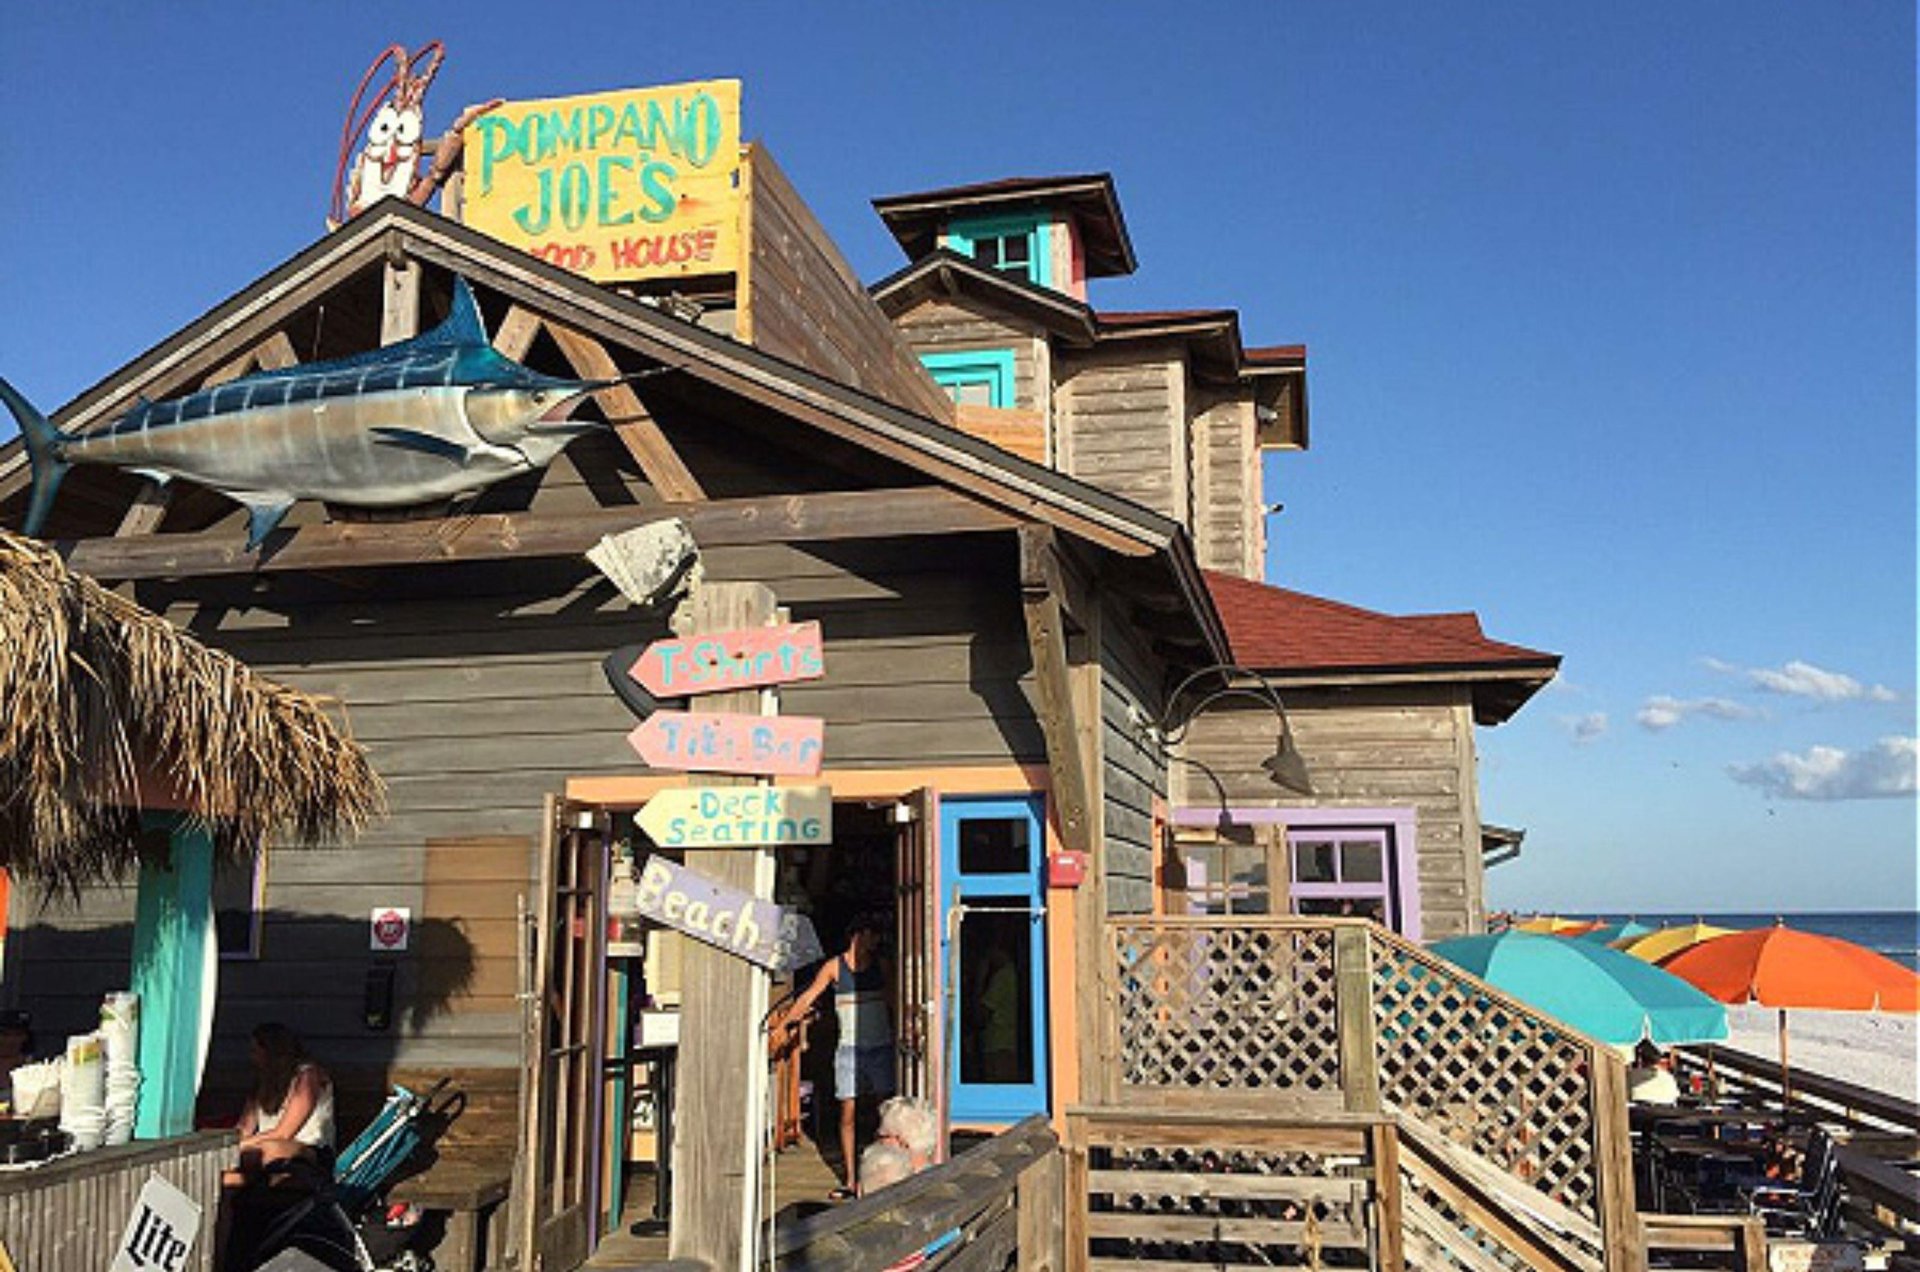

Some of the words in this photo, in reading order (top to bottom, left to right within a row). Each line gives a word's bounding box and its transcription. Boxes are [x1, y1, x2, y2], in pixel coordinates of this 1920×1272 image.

[475, 92, 721, 197] POMPANO
[512, 153, 678, 235] JOE'S
[611, 230, 717, 271] HOUSE
[636, 861, 760, 951] Beach
[126, 1204, 187, 1272] Lite
